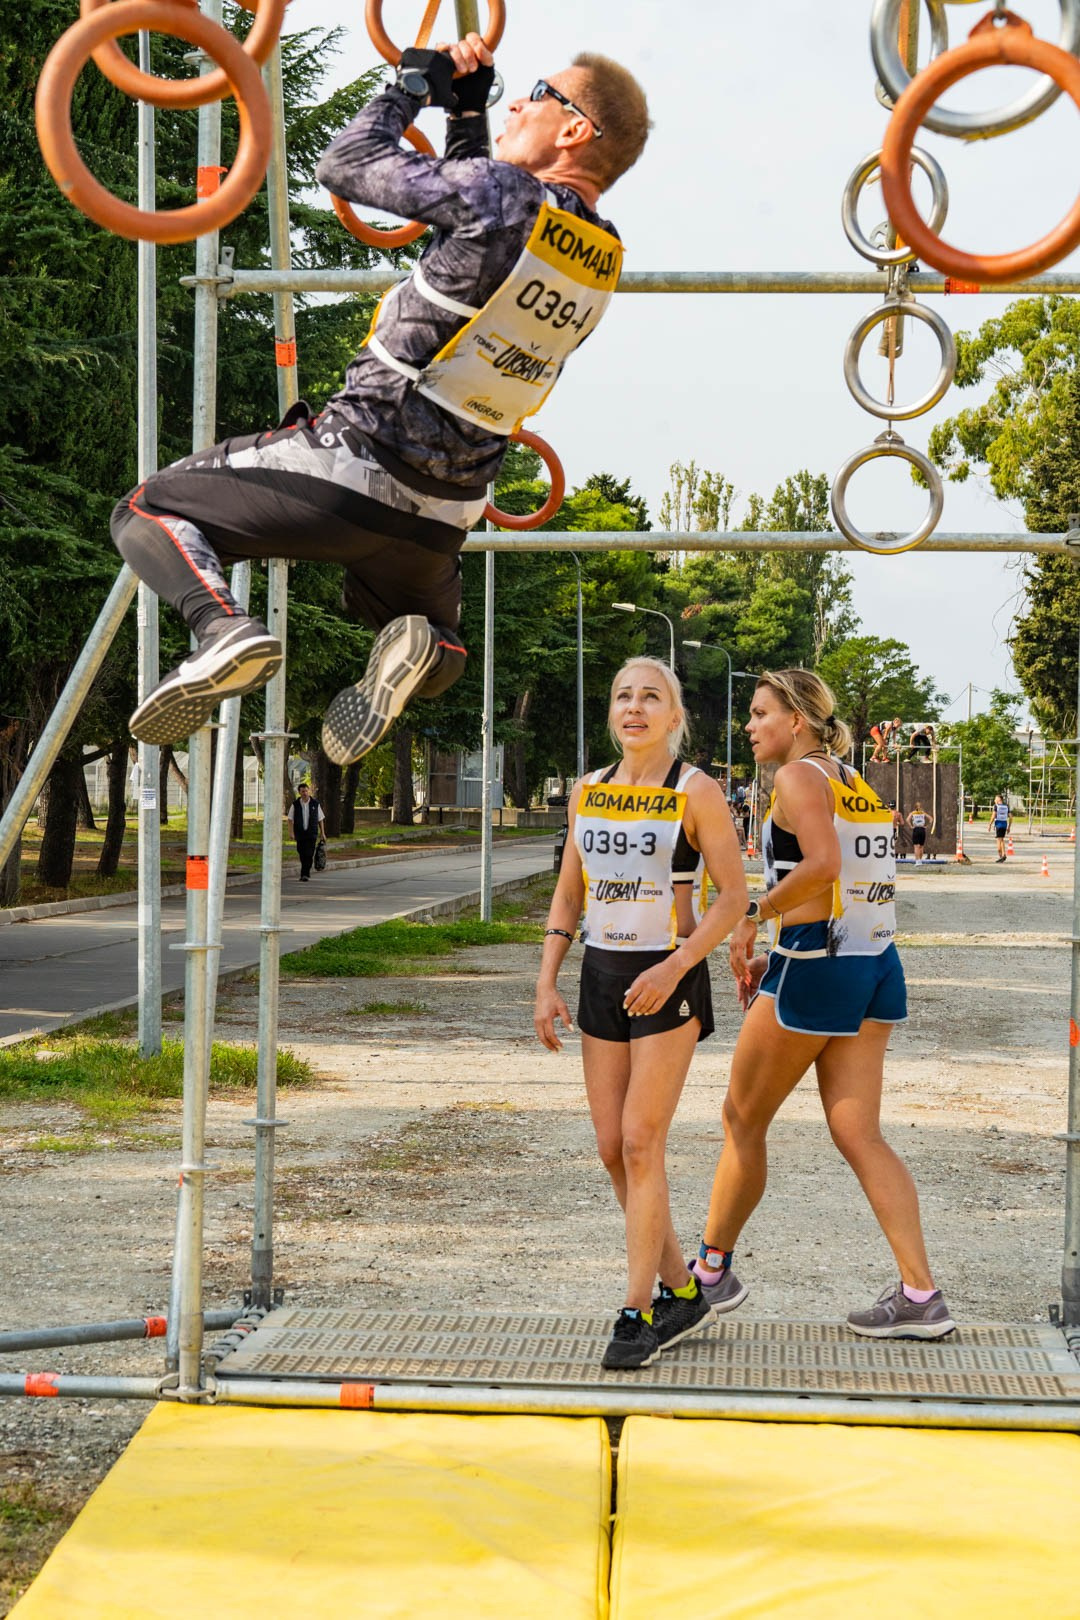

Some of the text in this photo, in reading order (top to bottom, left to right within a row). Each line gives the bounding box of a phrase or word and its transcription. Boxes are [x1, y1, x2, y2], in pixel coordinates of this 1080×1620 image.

[492, 343, 553, 384] URBAN
[466, 399, 505, 421] INGRAD
[584, 791, 678, 814] КОМАНДА
[582, 829, 657, 856] 039-3
[596, 876, 664, 902] URBAN ГЕРОЕВ
[604, 931, 638, 942] INGRAD
